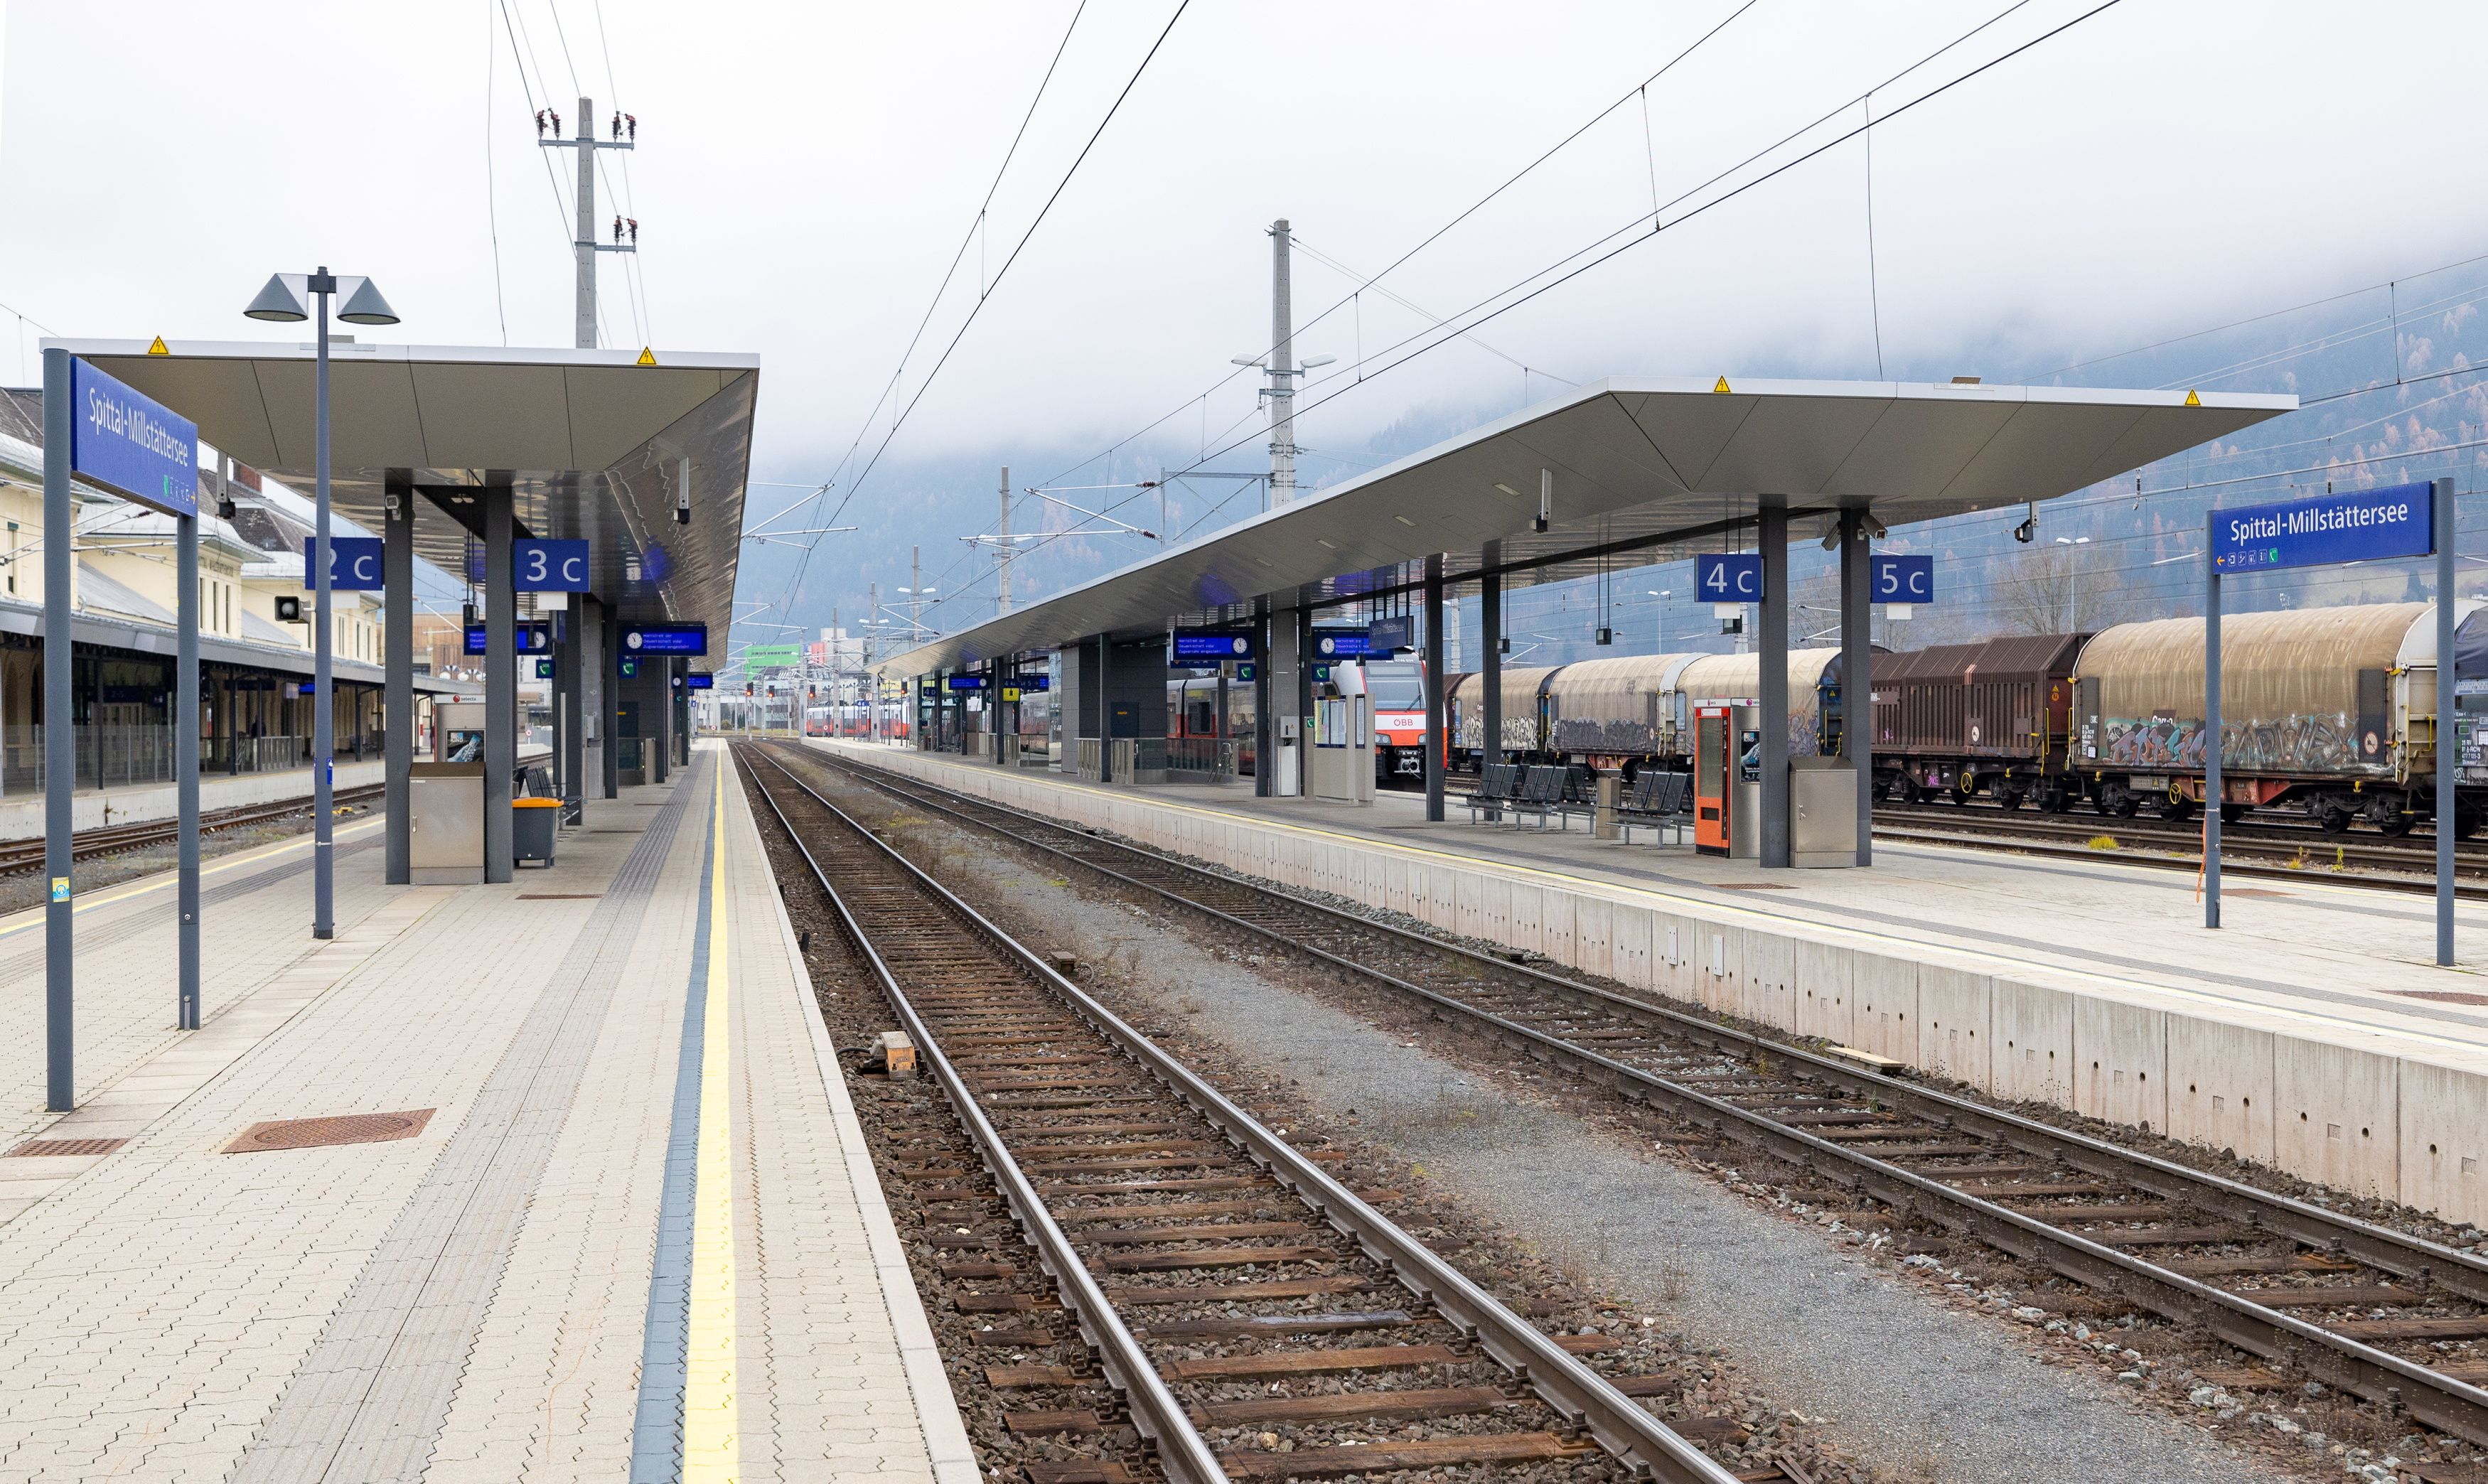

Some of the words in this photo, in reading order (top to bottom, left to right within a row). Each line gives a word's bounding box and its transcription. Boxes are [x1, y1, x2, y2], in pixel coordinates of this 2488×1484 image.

[90, 387, 188, 467] Spittal-Millstättersee
[2231, 502, 2408, 546] Spittal-Millstättersee
[526, 549, 547, 581] 3
[1706, 562, 1727, 593] 4
[1881, 564, 1898, 594] 5
